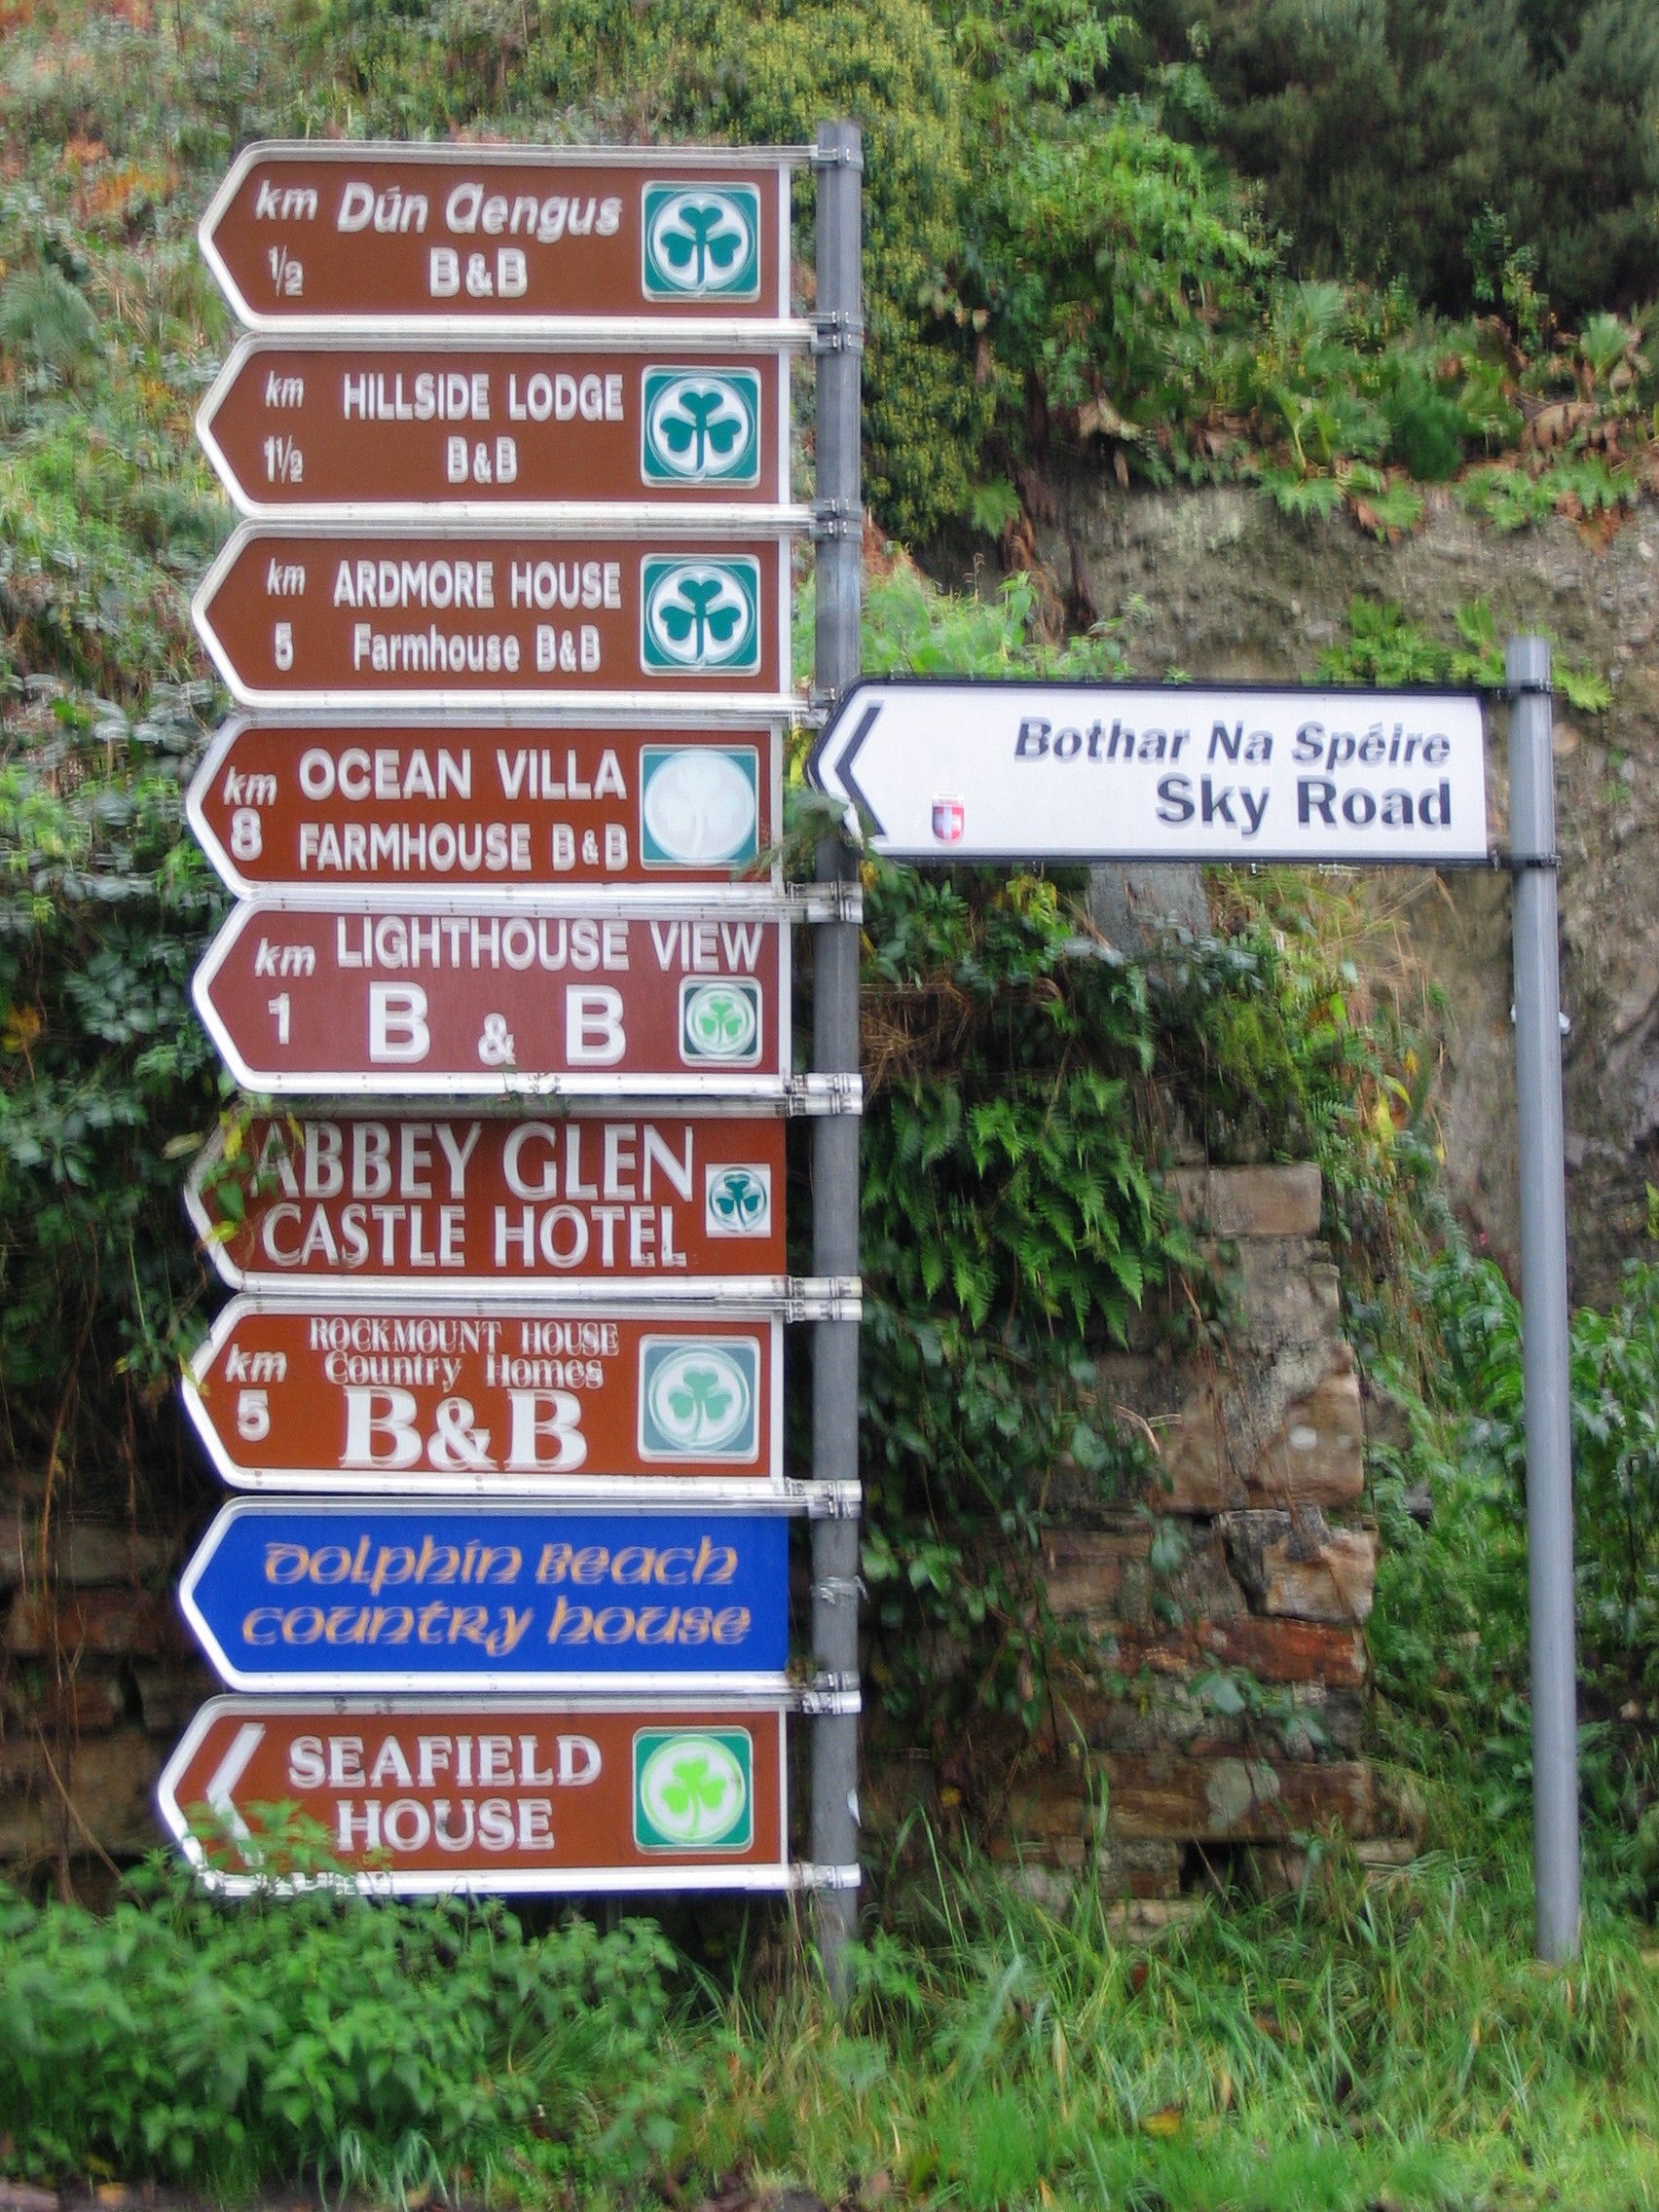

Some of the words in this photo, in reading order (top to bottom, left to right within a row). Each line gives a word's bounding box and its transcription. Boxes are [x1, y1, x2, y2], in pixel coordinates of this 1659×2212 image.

[255, 180, 318, 221] km
[337, 181, 428, 234] Dún
[445, 182, 623, 244] Aengus
[430, 246, 528, 298] B&B
[265, 371, 304, 409] km
[343, 373, 491, 422] HILLSIDE
[509, 374, 624, 422] LODGE
[447, 436, 518, 484] B&B
[267, 558, 306, 597] km
[333, 560, 494, 609] ARDMORE
[511, 561, 621, 609] HOUSE
[274, 622, 293, 672] 5
[353, 623, 520, 673] Farmhouse
[535, 624, 601, 673] B&B
[1014, 716, 1190, 762] Bothar
[1207, 719, 1274, 765] Na
[1293, 720, 1452, 772] Spéire
[223, 766, 277, 806] km
[298, 748, 471, 801] OCEAN
[497, 749, 628, 800] VILLA
[1156, 772, 1270, 841] Sky
[1296, 775, 1452, 827] Road
[230, 807, 263, 862] 8
[300, 823, 532, 872] FARMHOUSE
[254, 938, 315, 977] km
[337, 915, 630, 972] LIGHTHOUSE
[649, 920, 763, 974] VIEW
[268, 992, 290, 1046] 1
[369, 980, 431, 1064] B
[477, 1013, 517, 1066] &
[565, 984, 627, 1067] B
[251, 1121, 482, 1199] ABBEY
[501, 1121, 694, 1203] GLEN
[262, 1202, 466, 1269] CASTLE
[494, 1204, 687, 1270] HOTEL
[310, 1317, 502, 1353] ROCKMOUNT
[521, 1321, 620, 1356] HOUSE
[226, 1344, 287, 1383] km
[324, 1349, 461, 1393] Country
[487, 1353, 605, 1389] Homes
[236, 1389, 271, 1441] 5
[340, 1385, 588, 1472] B&B
[288, 1734, 603, 1789] SEAFIELD
[337, 1797, 556, 1852] HOUSE
